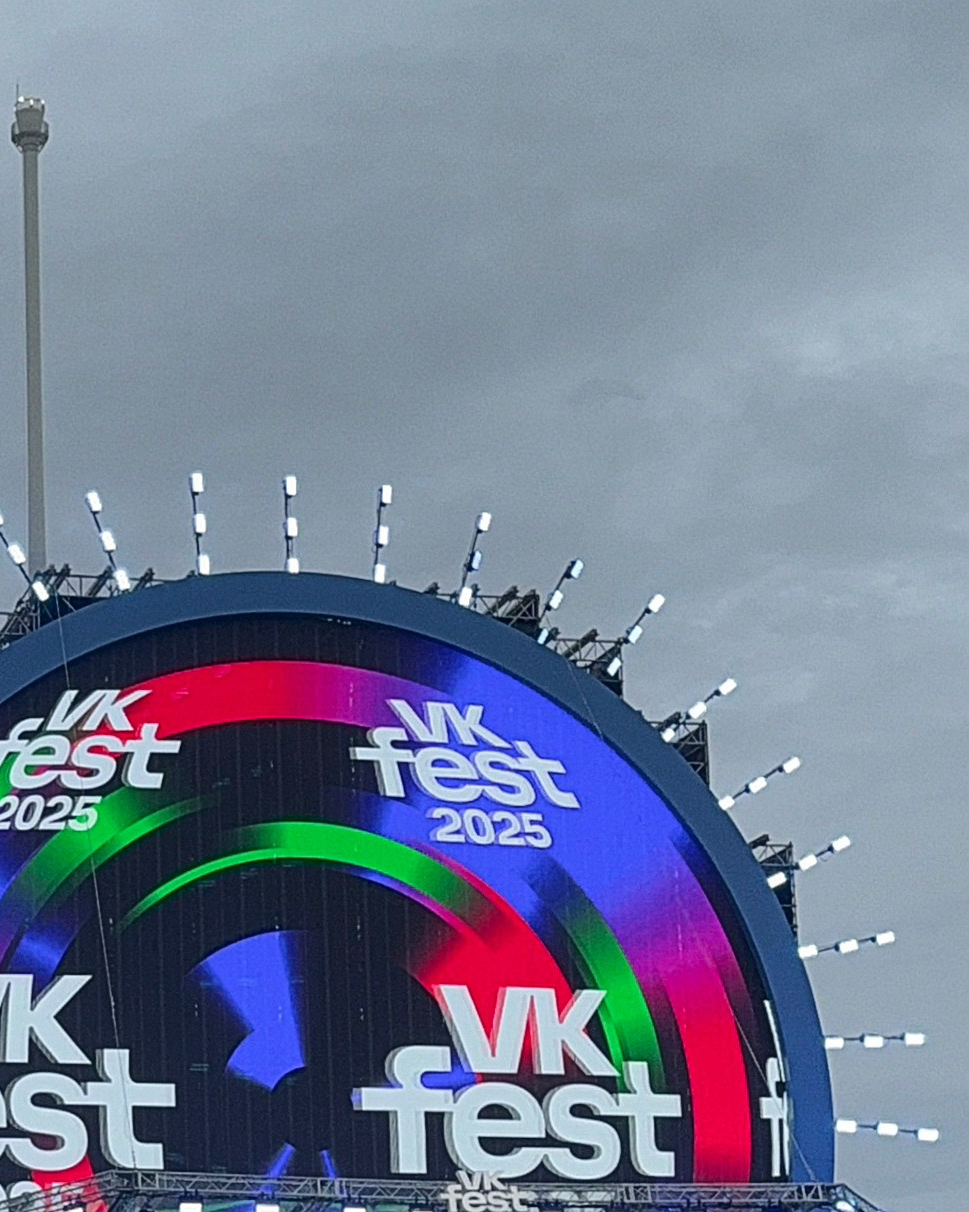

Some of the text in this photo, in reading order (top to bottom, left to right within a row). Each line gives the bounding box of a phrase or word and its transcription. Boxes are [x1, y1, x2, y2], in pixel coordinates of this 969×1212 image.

[43, 689, 152, 731] VK
[385, 699, 510, 749] VK
[350, 727, 580, 808] fest
[429, 808, 553, 849] 2025
[433, 984, 621, 1077] VK
[351, 1045, 681, 1180] fest
[440, 1184, 529, 1212] fest
[455, 1170, 508, 1190] VK
